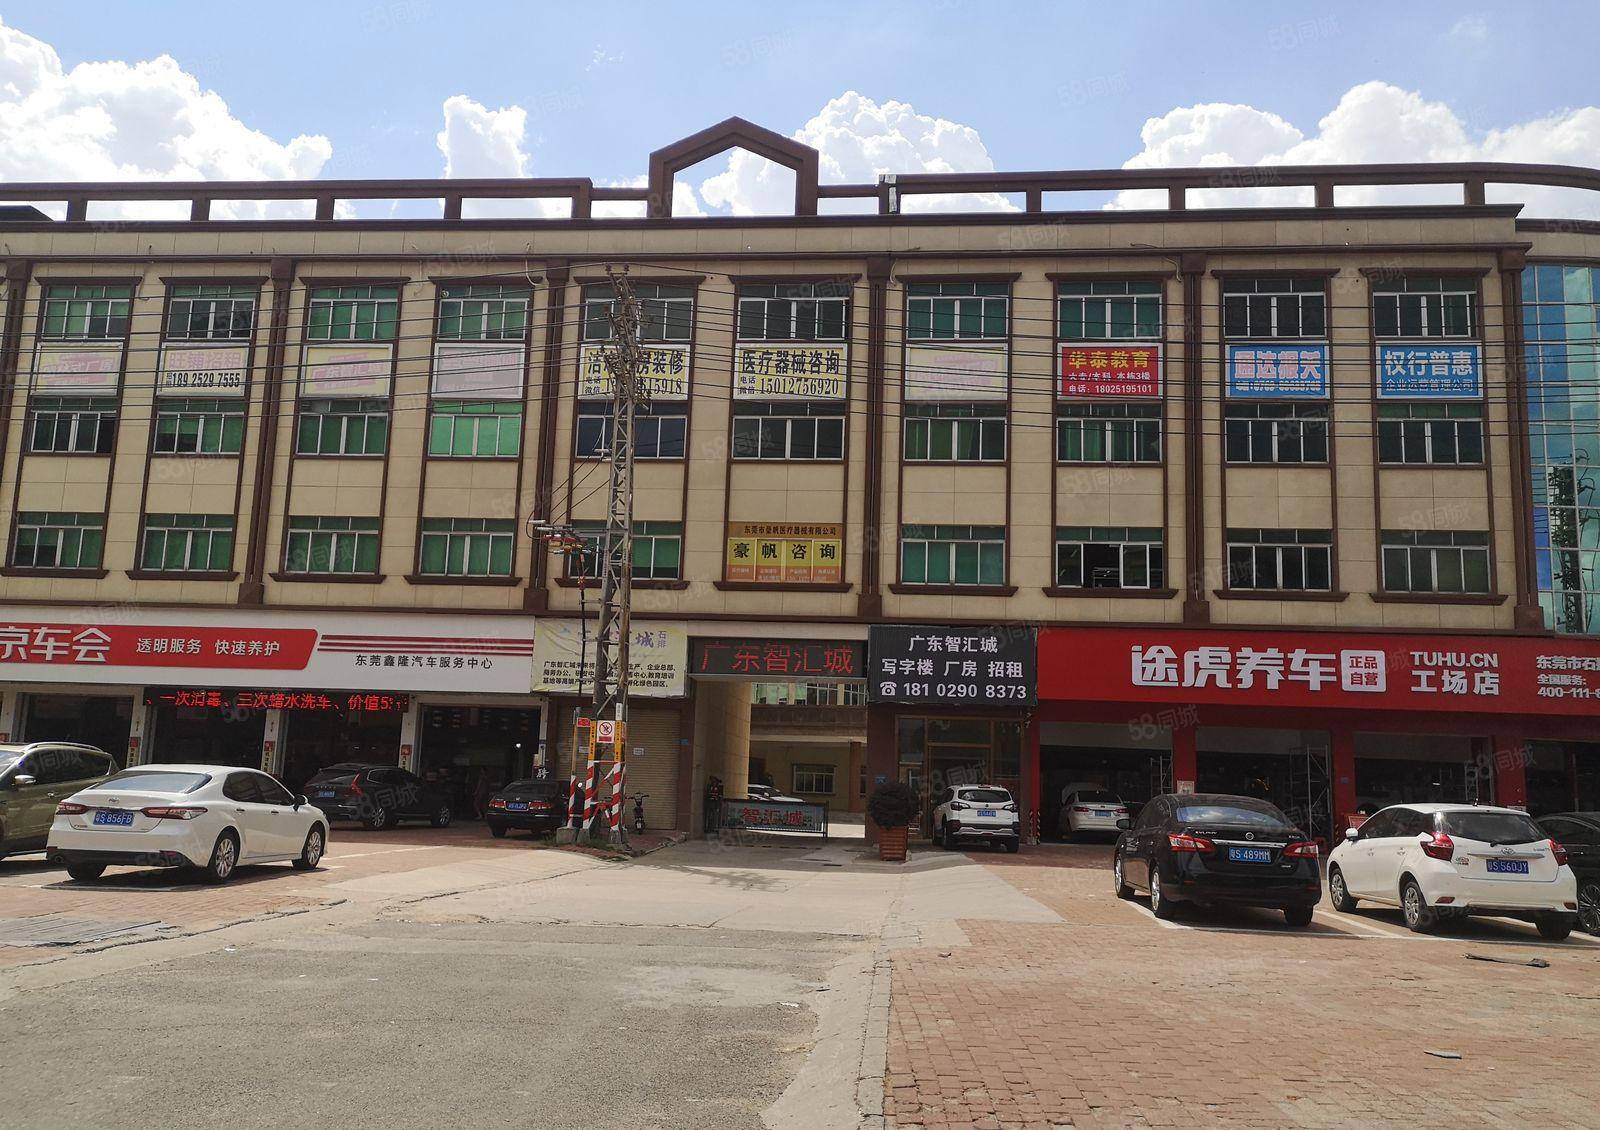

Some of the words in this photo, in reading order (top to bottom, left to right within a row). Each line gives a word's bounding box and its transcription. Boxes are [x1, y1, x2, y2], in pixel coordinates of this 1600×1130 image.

[742, 350, 839, 374] 医疗器械咨询
[1069, 351, 1150, 368] 华泰教育
[1384, 350, 1473, 375] 权行普惠
[172, 373, 188, 387] 189
[191, 373, 214, 387] 2529
[217, 372, 241, 387] 7555
[741, 376, 756, 384] 电话
[1095, 385, 1152, 393] 18025195101
[0, 626, 112, 662] 京车会
[137, 638, 202, 654] 透明服务
[214, 639, 280, 656] 快速养护
[909, 635, 998, 653] 广东智汇城
[355, 654, 493, 669] 东莞鑫隆汽车服务中心
[702, 641, 854, 673] 广东智汇城
[1349, 655, 1378, 669] 正品
[1410, 651, 1499, 667] TUHU.CN
[881, 658, 934, 676] 写字楼
[943, 660, 978, 677] 厂房
[988, 660, 1023, 678] 招租
[1132, 645, 1337, 691] 途虎养车
[1350, 671, 1378, 686] 自营
[1411, 669, 1499, 696] 工场店
[1537, 674, 1587, 686] 全国服务:
[903, 682, 929, 696] 181
[936, 684, 978, 697] 0290
[985, 685, 1027, 699] 8373
[743, 807, 804, 825] 智汇城
